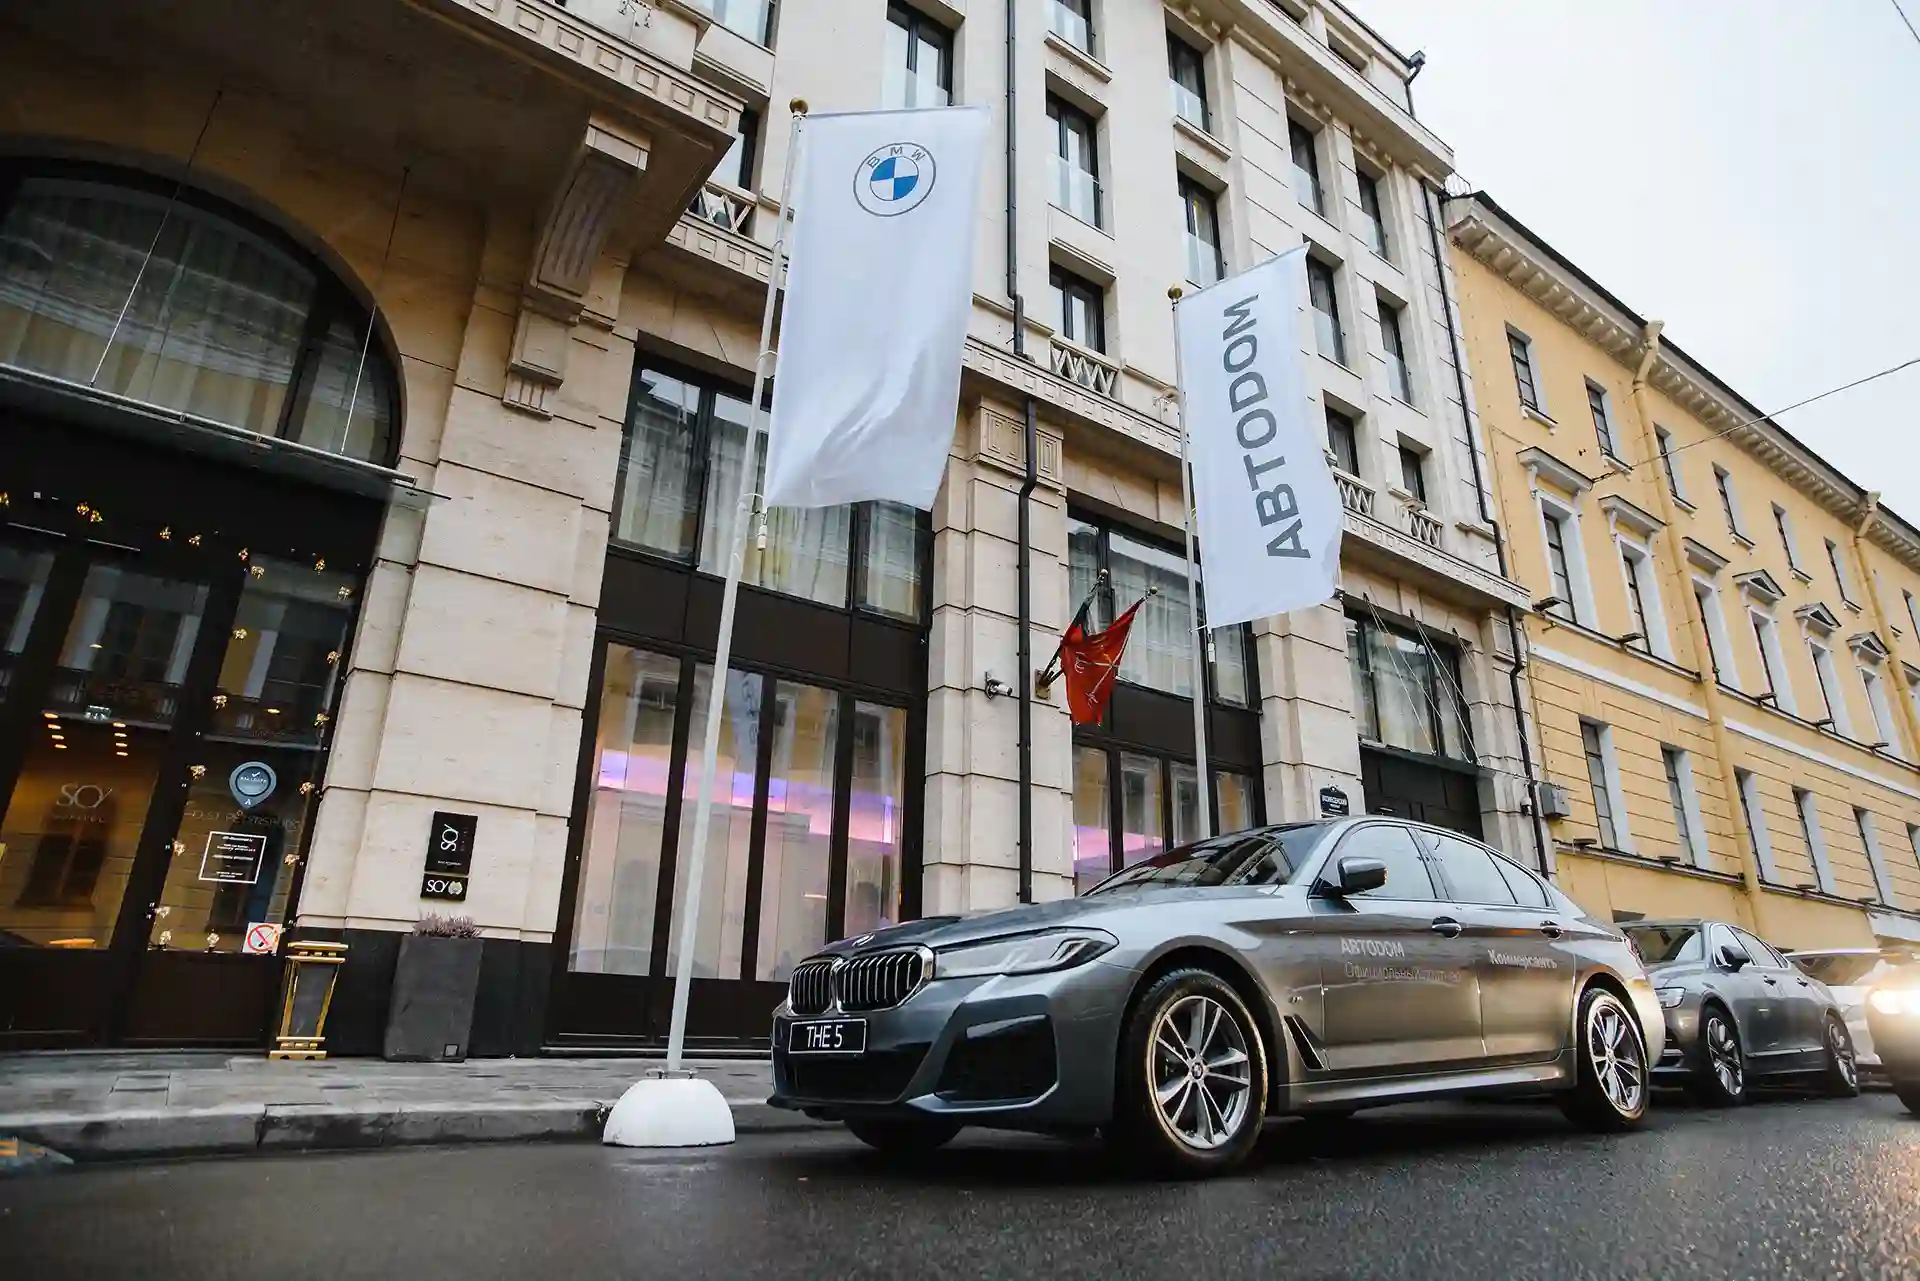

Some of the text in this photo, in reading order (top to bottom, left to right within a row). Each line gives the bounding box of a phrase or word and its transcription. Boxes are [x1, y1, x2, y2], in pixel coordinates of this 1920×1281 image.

[866, 146, 926, 169] BMW
[806, 1024, 843, 1049] THE 5
